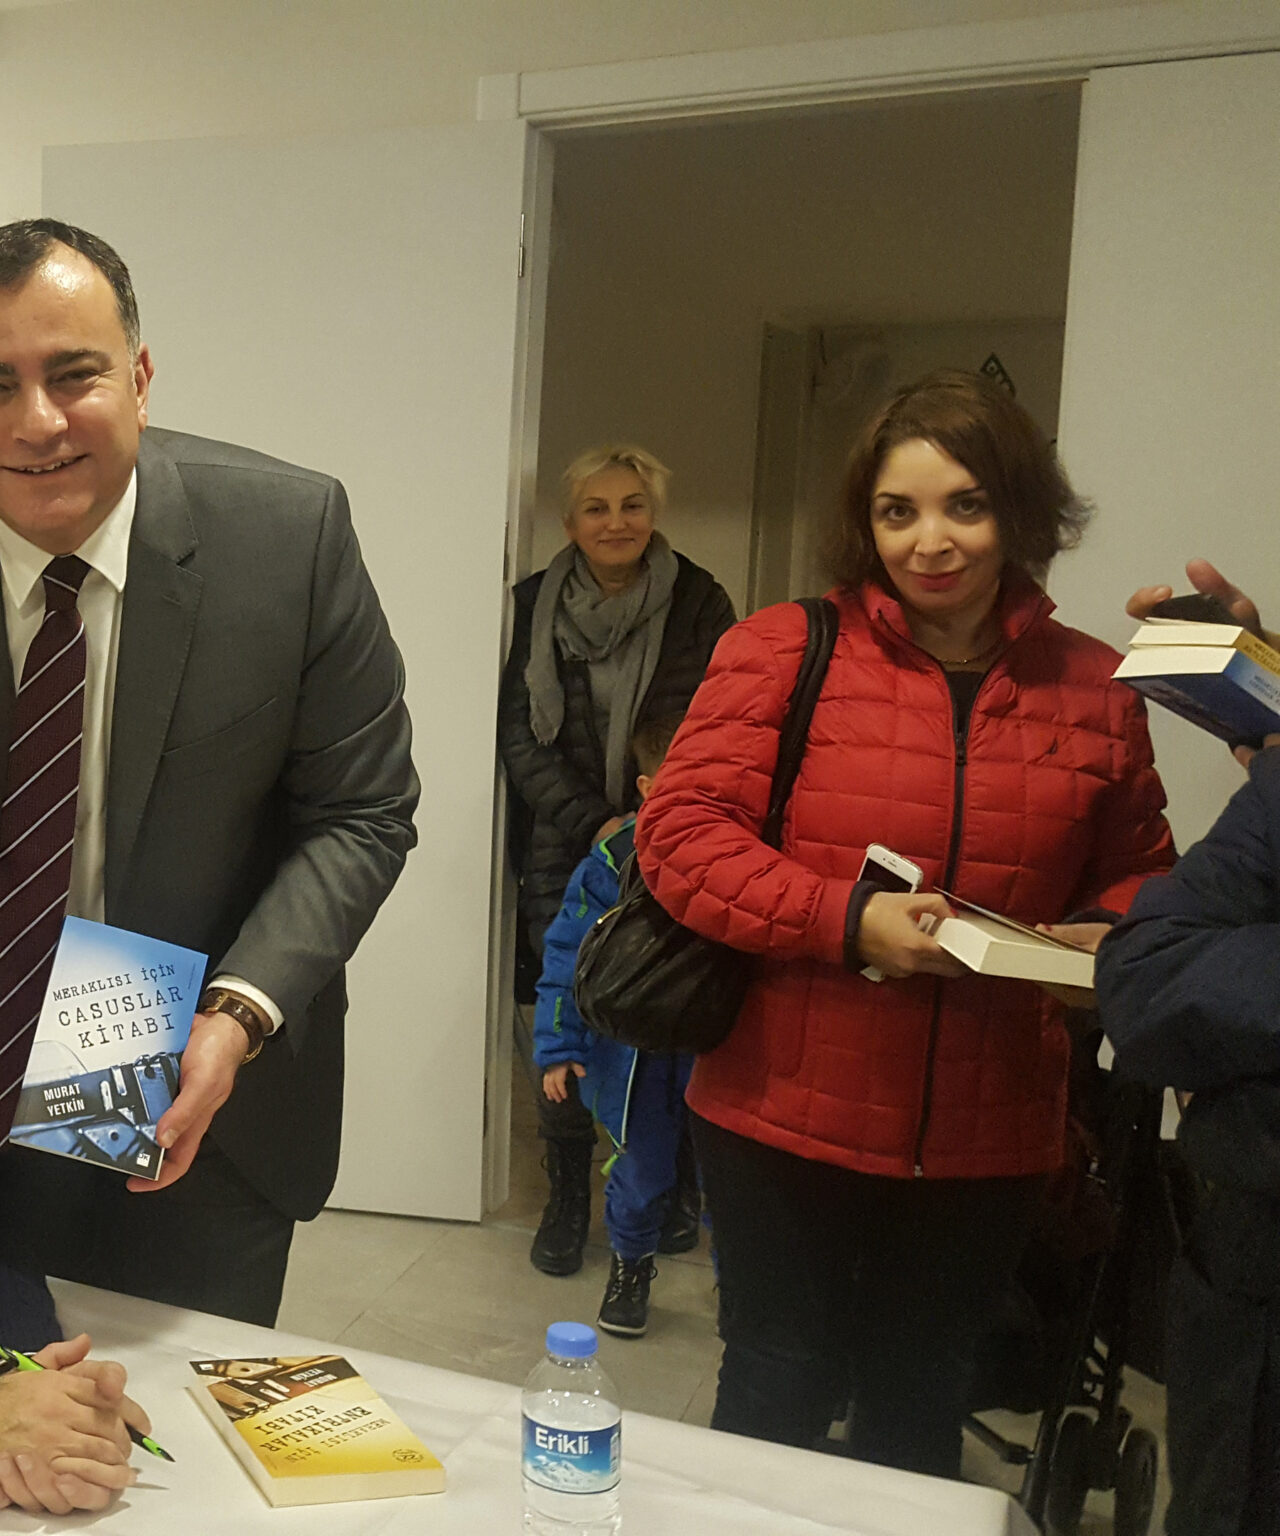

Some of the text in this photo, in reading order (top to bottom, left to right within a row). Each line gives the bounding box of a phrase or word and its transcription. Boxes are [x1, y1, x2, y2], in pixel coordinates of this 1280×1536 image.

[52, 963, 176, 1001] MERAKLISI İÇİN
[58, 986, 184, 1026] CASUSLAR
[77, 1013, 175, 1049] KİTABI
[43, 1082, 82, 1102] MURAT
[46, 1097, 85, 1117] YETKİN
[254, 1404, 326, 1436] KİTABI
[259, 1405, 373, 1452] ENTRİKALAR
[535, 1426, 590, 1455] Erikli
